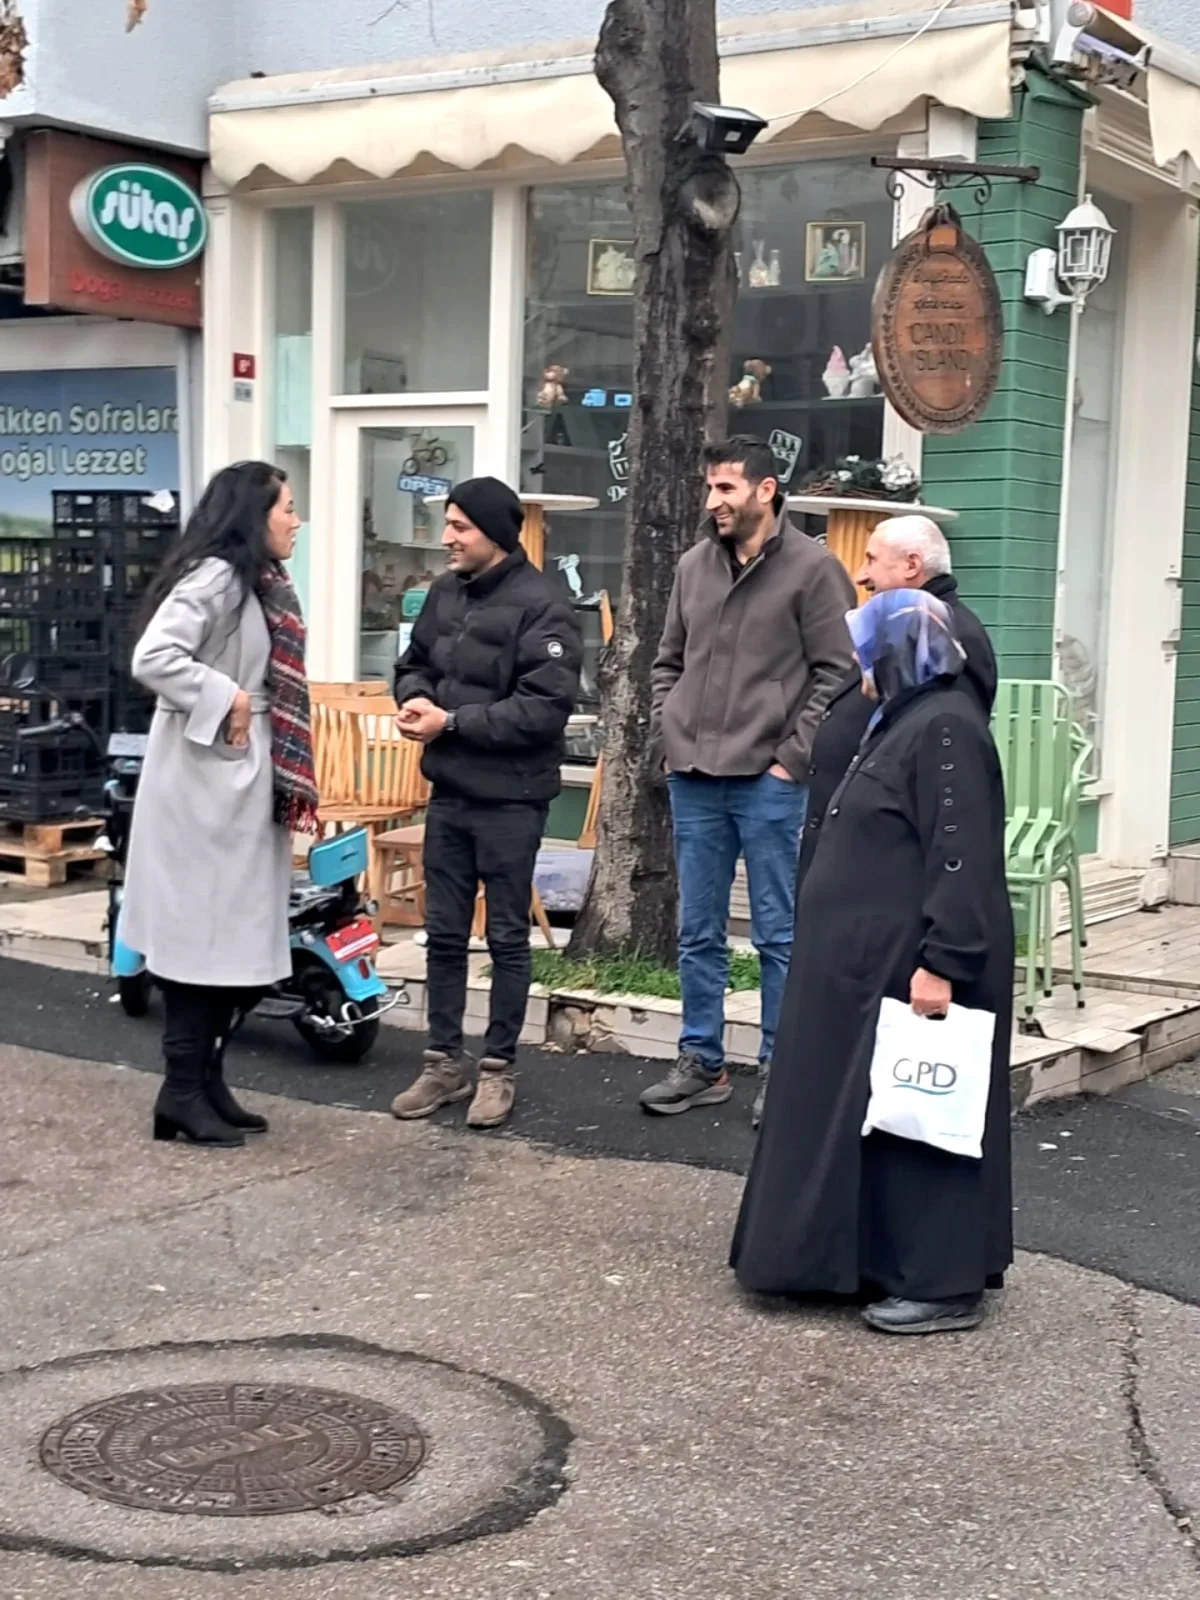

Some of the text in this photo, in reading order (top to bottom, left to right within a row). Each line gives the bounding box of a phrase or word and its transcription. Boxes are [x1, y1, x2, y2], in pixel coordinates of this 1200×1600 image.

[101, 179, 195, 253] sütaş
[910, 322, 966, 345] CANDY
[62, 446, 147, 474] Lezzet
[400, 478, 449, 496] OPEN
[892, 1057, 957, 1088] GPD
